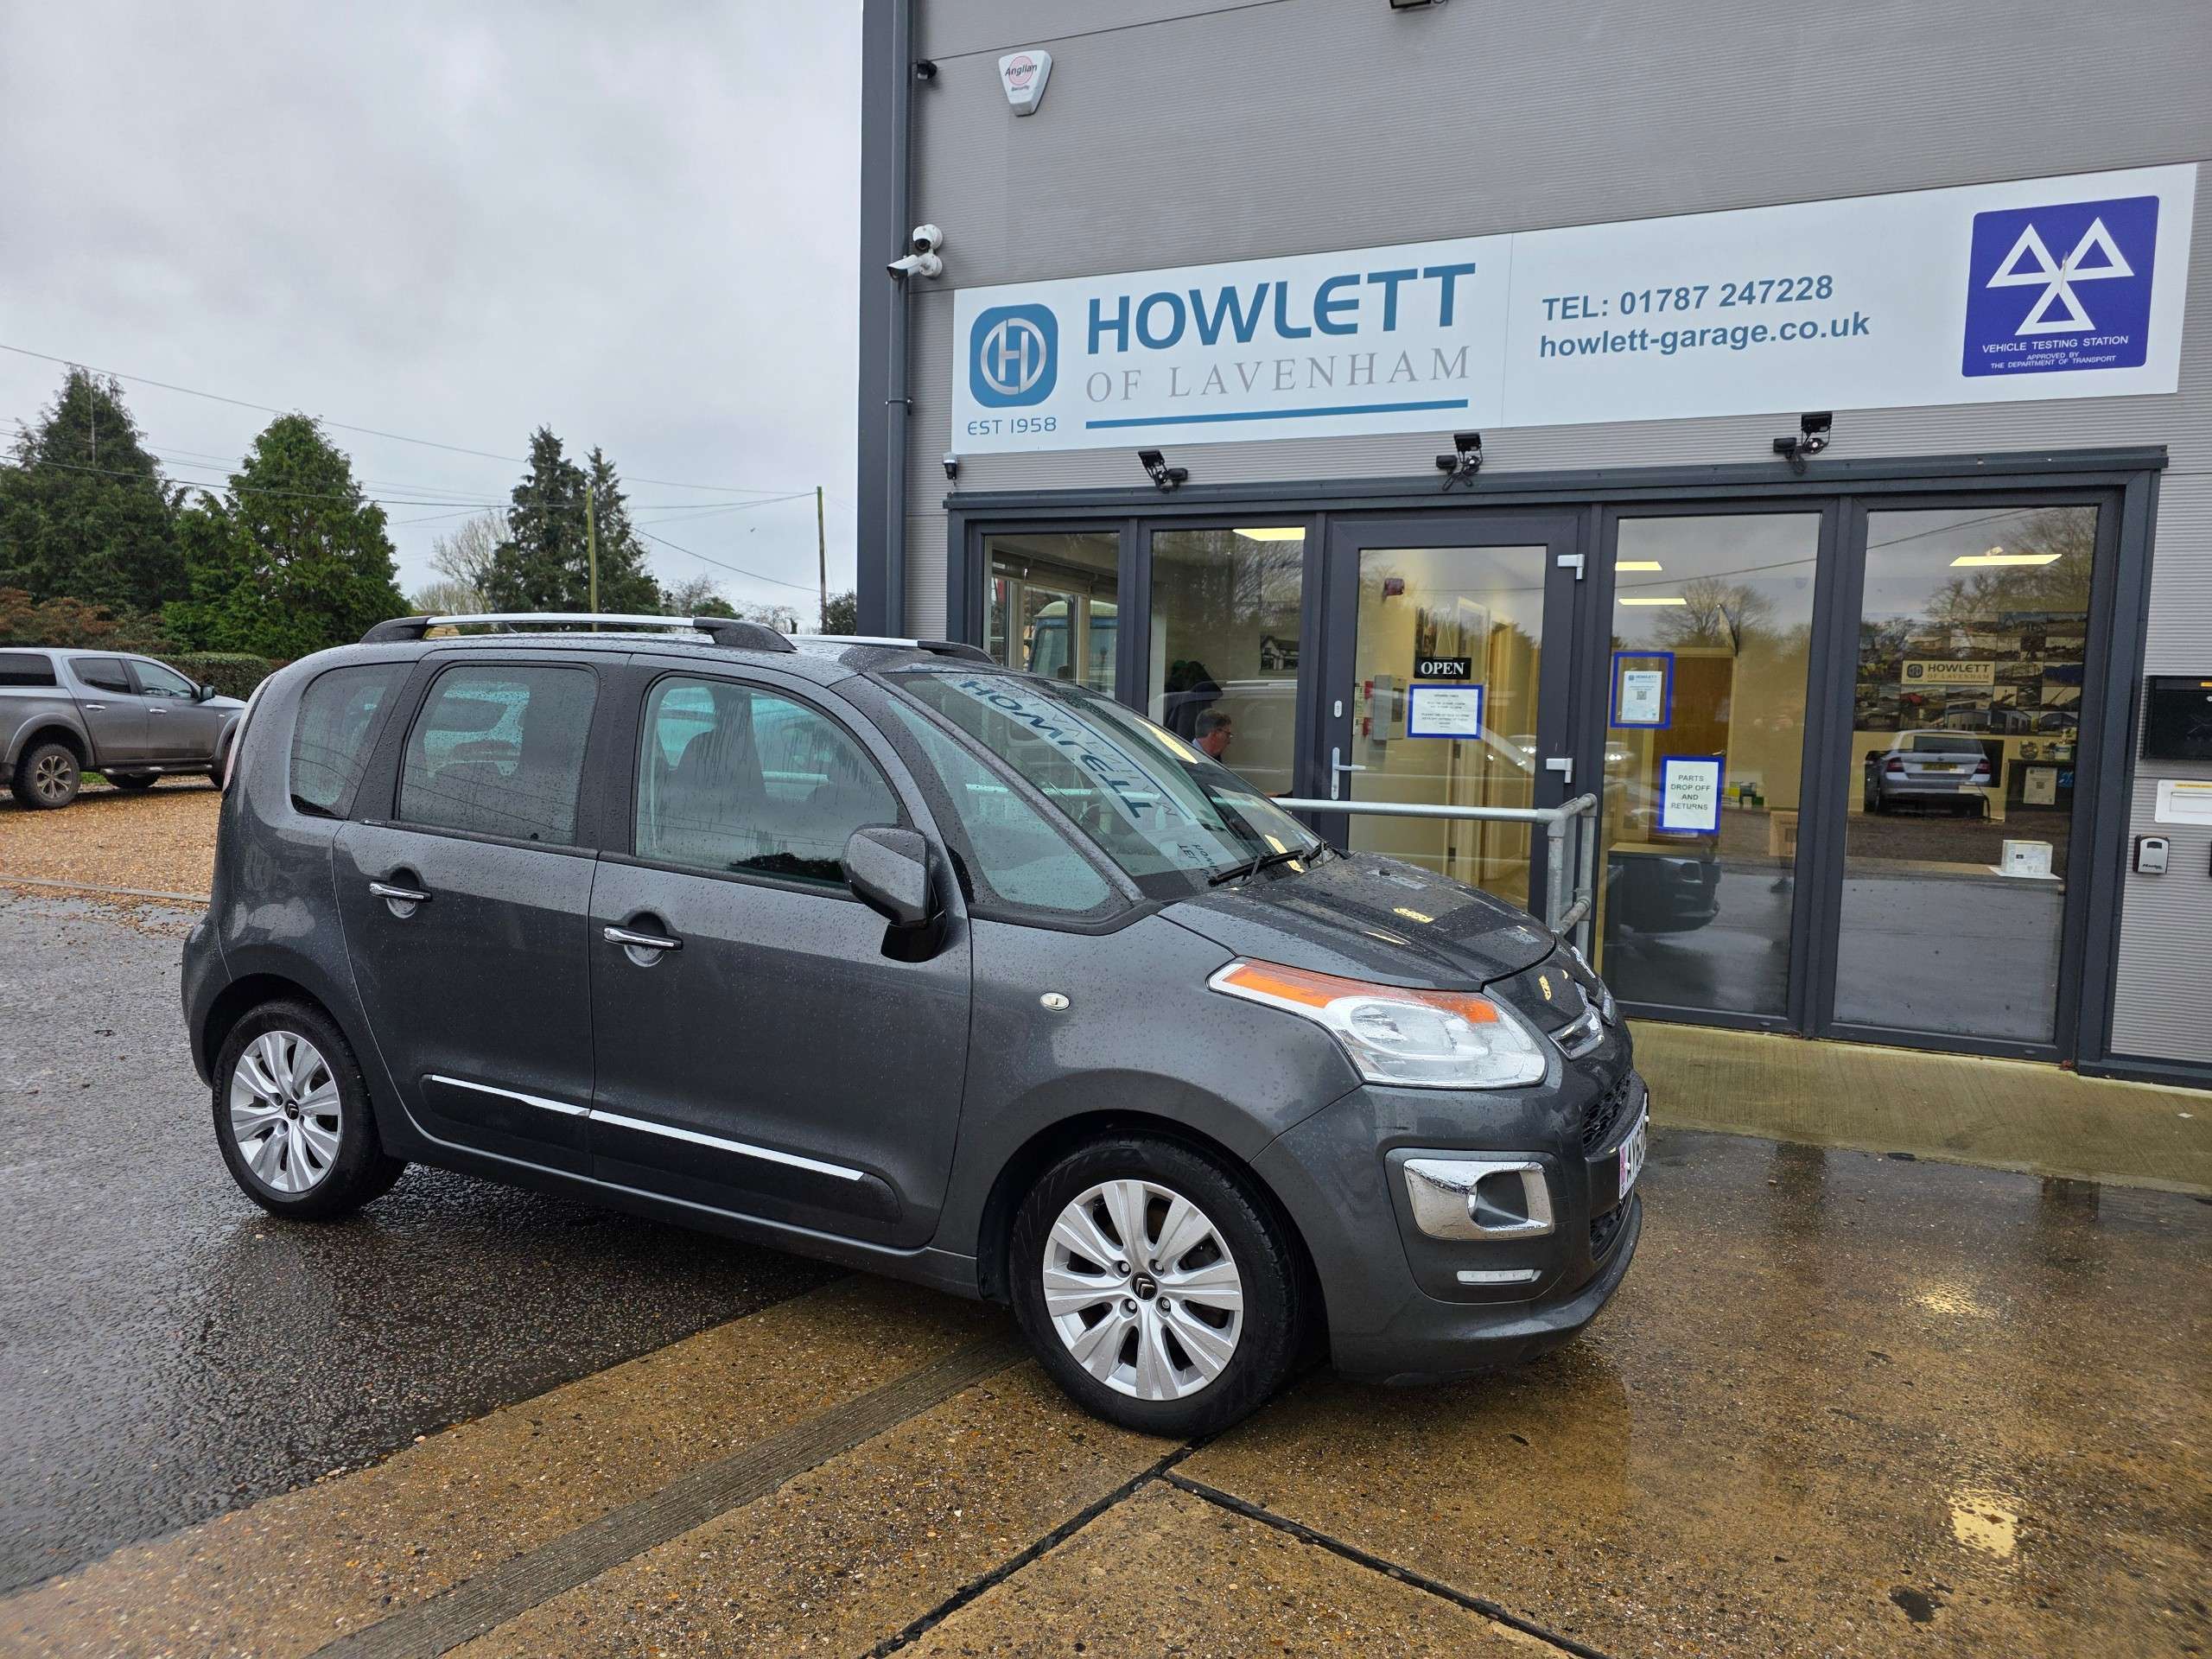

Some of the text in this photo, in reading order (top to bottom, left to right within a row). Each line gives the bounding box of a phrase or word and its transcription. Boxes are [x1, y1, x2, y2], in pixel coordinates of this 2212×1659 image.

[1005, 64, 1037, 76] Anglian
[1542, 274, 1834, 321] TEL: 01787 247228
[1087, 263, 1476, 354] HOWLETT
[1539, 311, 1870, 359] howlett-garage.co.uk
[1982, 335, 2129, 353] VEHICLE TESTING STATION
[2008, 359, 2055, 369] DEPARTMENT
[2073, 355, 2117, 364] TRANSPORT
[2026, 352, 2066, 360] APPROVED
[1086, 345, 1470, 403] OF LAVENHAM
[968, 416, 1057, 435] EST 1958
[1421, 661, 1465, 675] OPEN
[1928, 664, 1991, 672] HOWLETT
